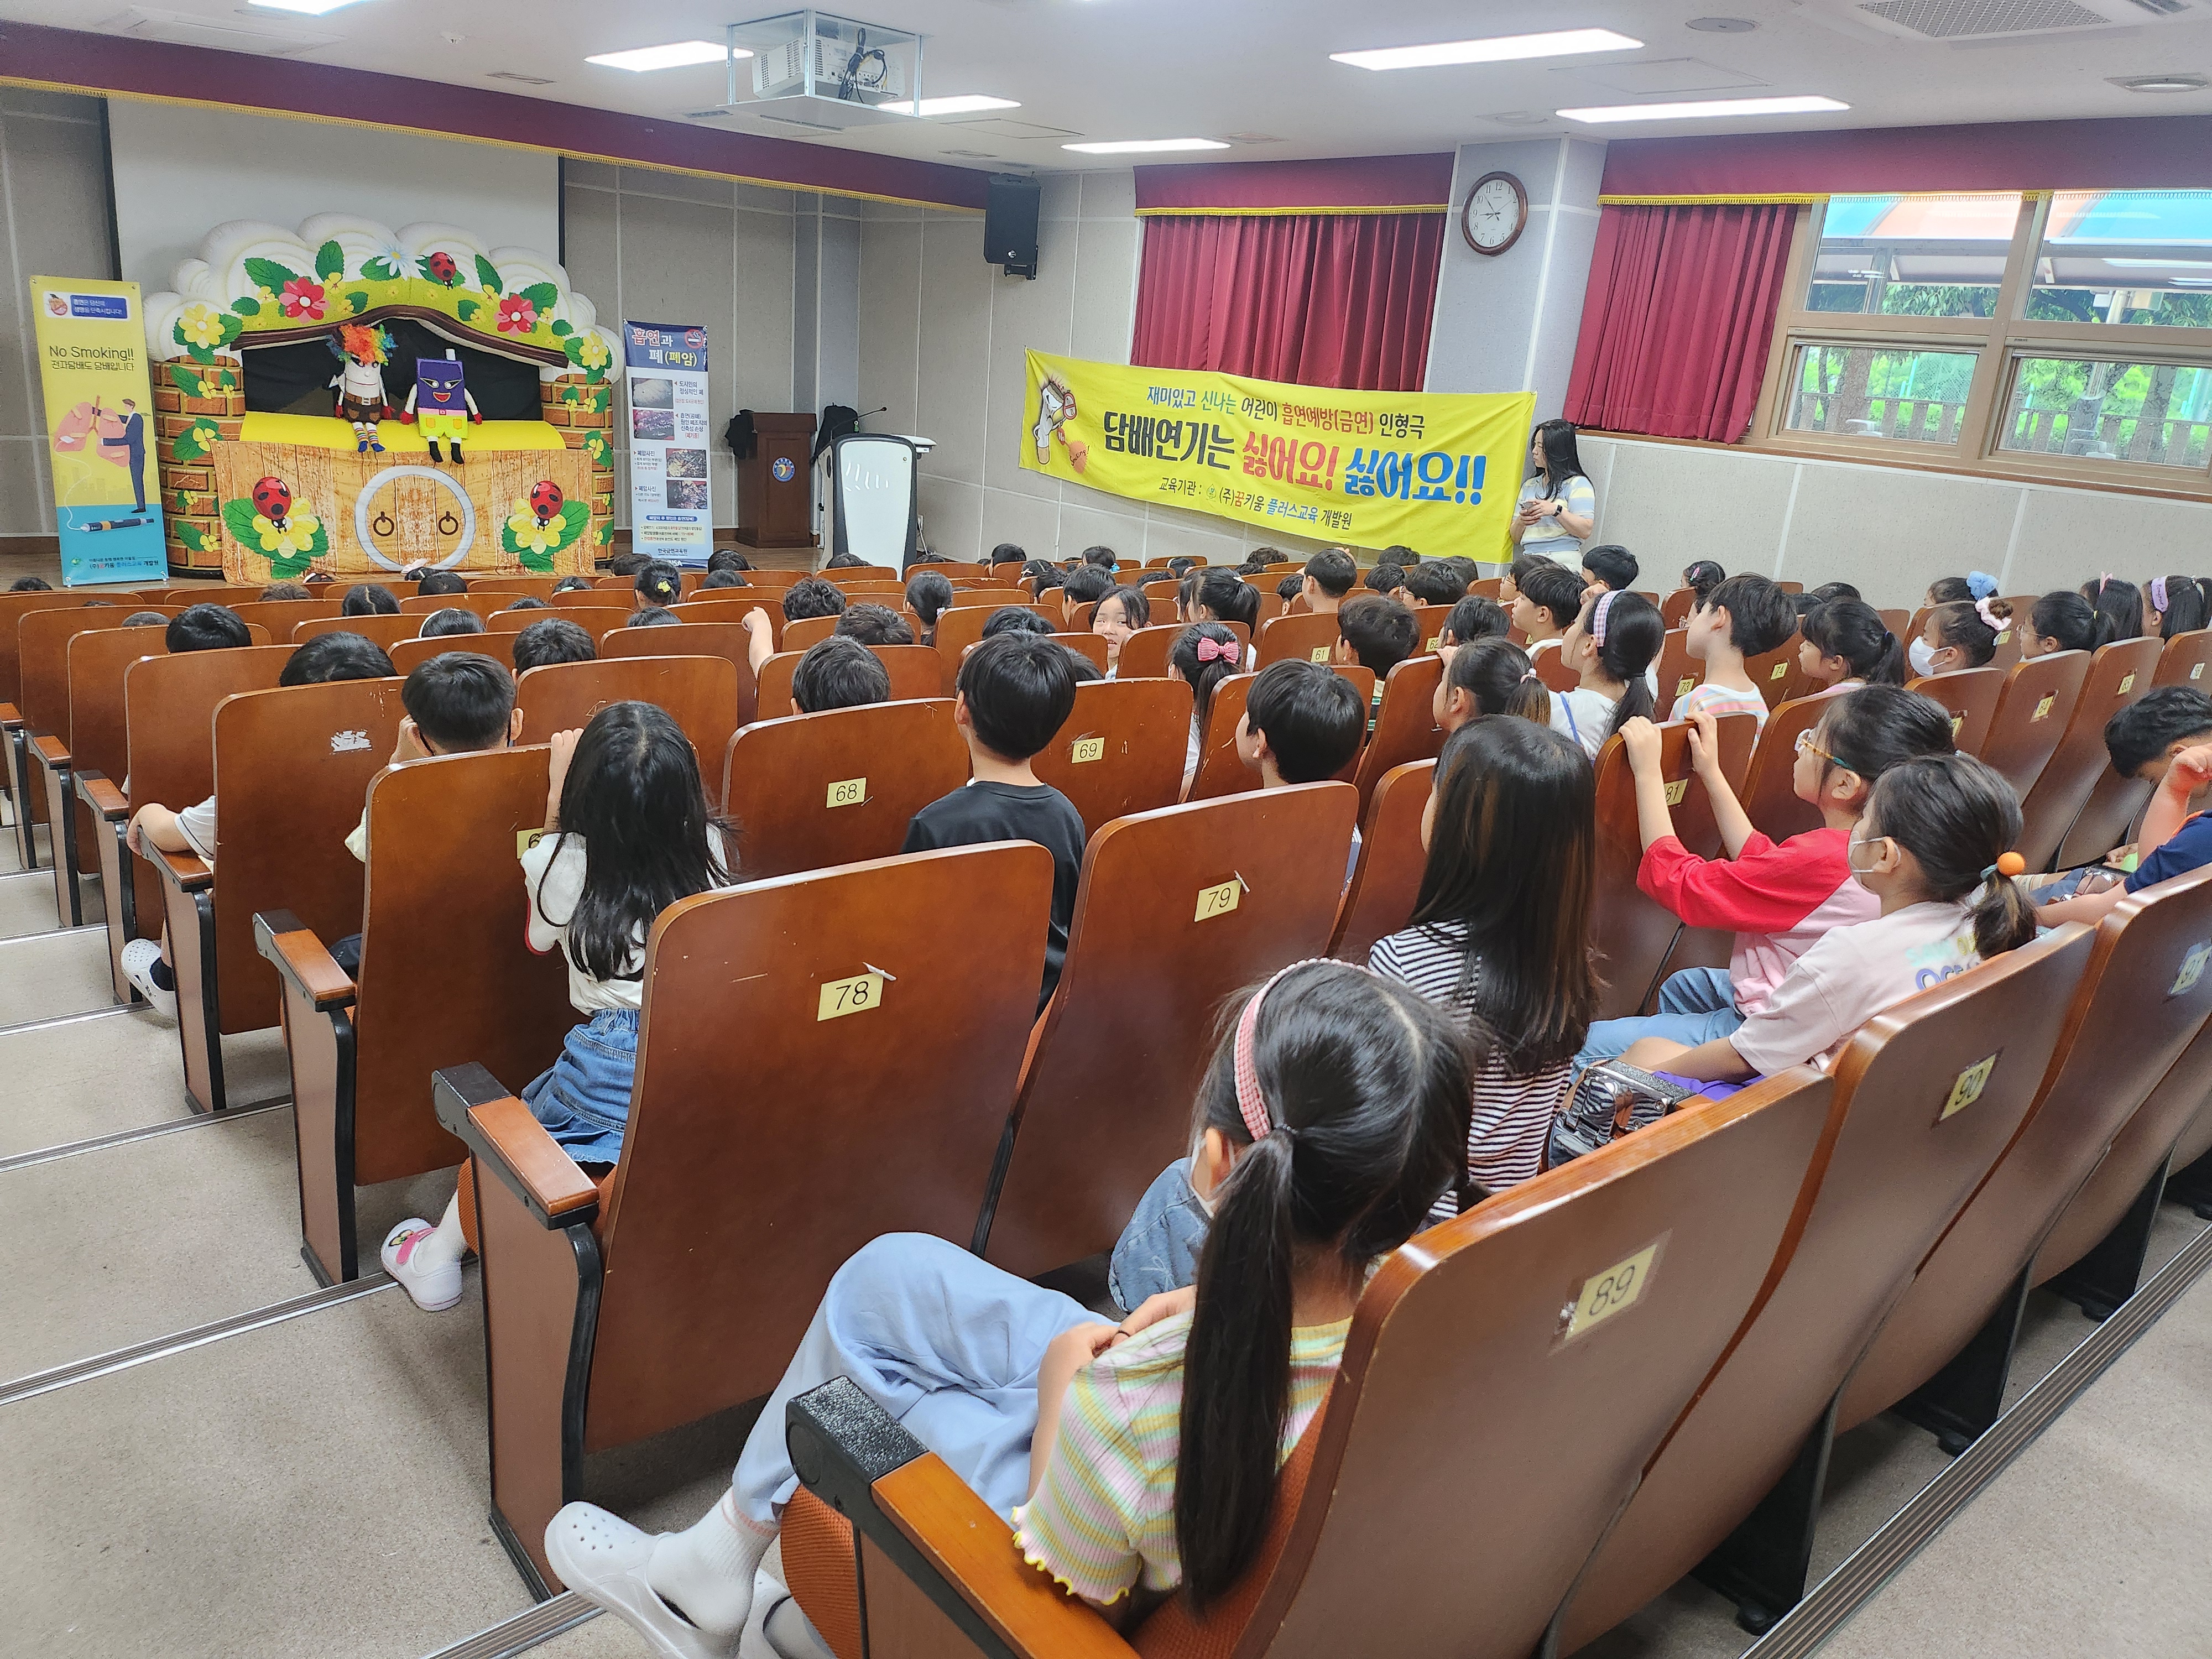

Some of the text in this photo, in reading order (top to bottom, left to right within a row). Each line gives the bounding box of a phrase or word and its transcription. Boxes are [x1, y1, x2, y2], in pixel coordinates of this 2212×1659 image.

[1486, 185, 1491, 194] 11
[1495, 182, 1503, 191] 12
[1507, 186, 1511, 194] 1
[1477, 196, 1483, 204] 10
[1513, 195, 1517, 204] 2
[1473, 210, 1478, 218] 9
[1514, 209, 1518, 217] 3
[1509, 222, 1513, 231] 4
[1480, 233, 1485, 242] 7
[1490, 236, 1494, 244] 6
[632, 328, 674, 347] 흡연과
[50, 346, 134, 361] No Smoking!!
[51, 360, 134, 372] 전자담배도 담배입니다
[1147, 386, 1425, 440] 재미있고 신나는 어린이 흡연예방(금연) 인형극
[1103, 411, 1487, 506] 담배연기는 싫어요! 싫어요!!
[1159, 477, 1197, 497] 교육기관
[1219, 487, 1264, 512] (주)꿈키움
[1266, 498, 1318, 524] 플러스교육
[1321, 510, 1353, 530] 개발원
[1430, 640, 1438, 649] 62
[1315, 649, 1325, 660] 61
[1776, 666, 1784, 676] 74
[1680, 681, 1690, 693] 73
[2038, 700, 2049, 714] 84
[1079, 742, 1097, 759] 69
[836, 783, 857, 802] 68
[1666, 784, 1680, 802] 81
[1208, 887, 1231, 912] 79
[2180, 952, 2206, 984] 91
[836, 981, 869, 1010] 78
[1954, 1068, 1984, 1106] 90
[1588, 1264, 1635, 1316] 89
